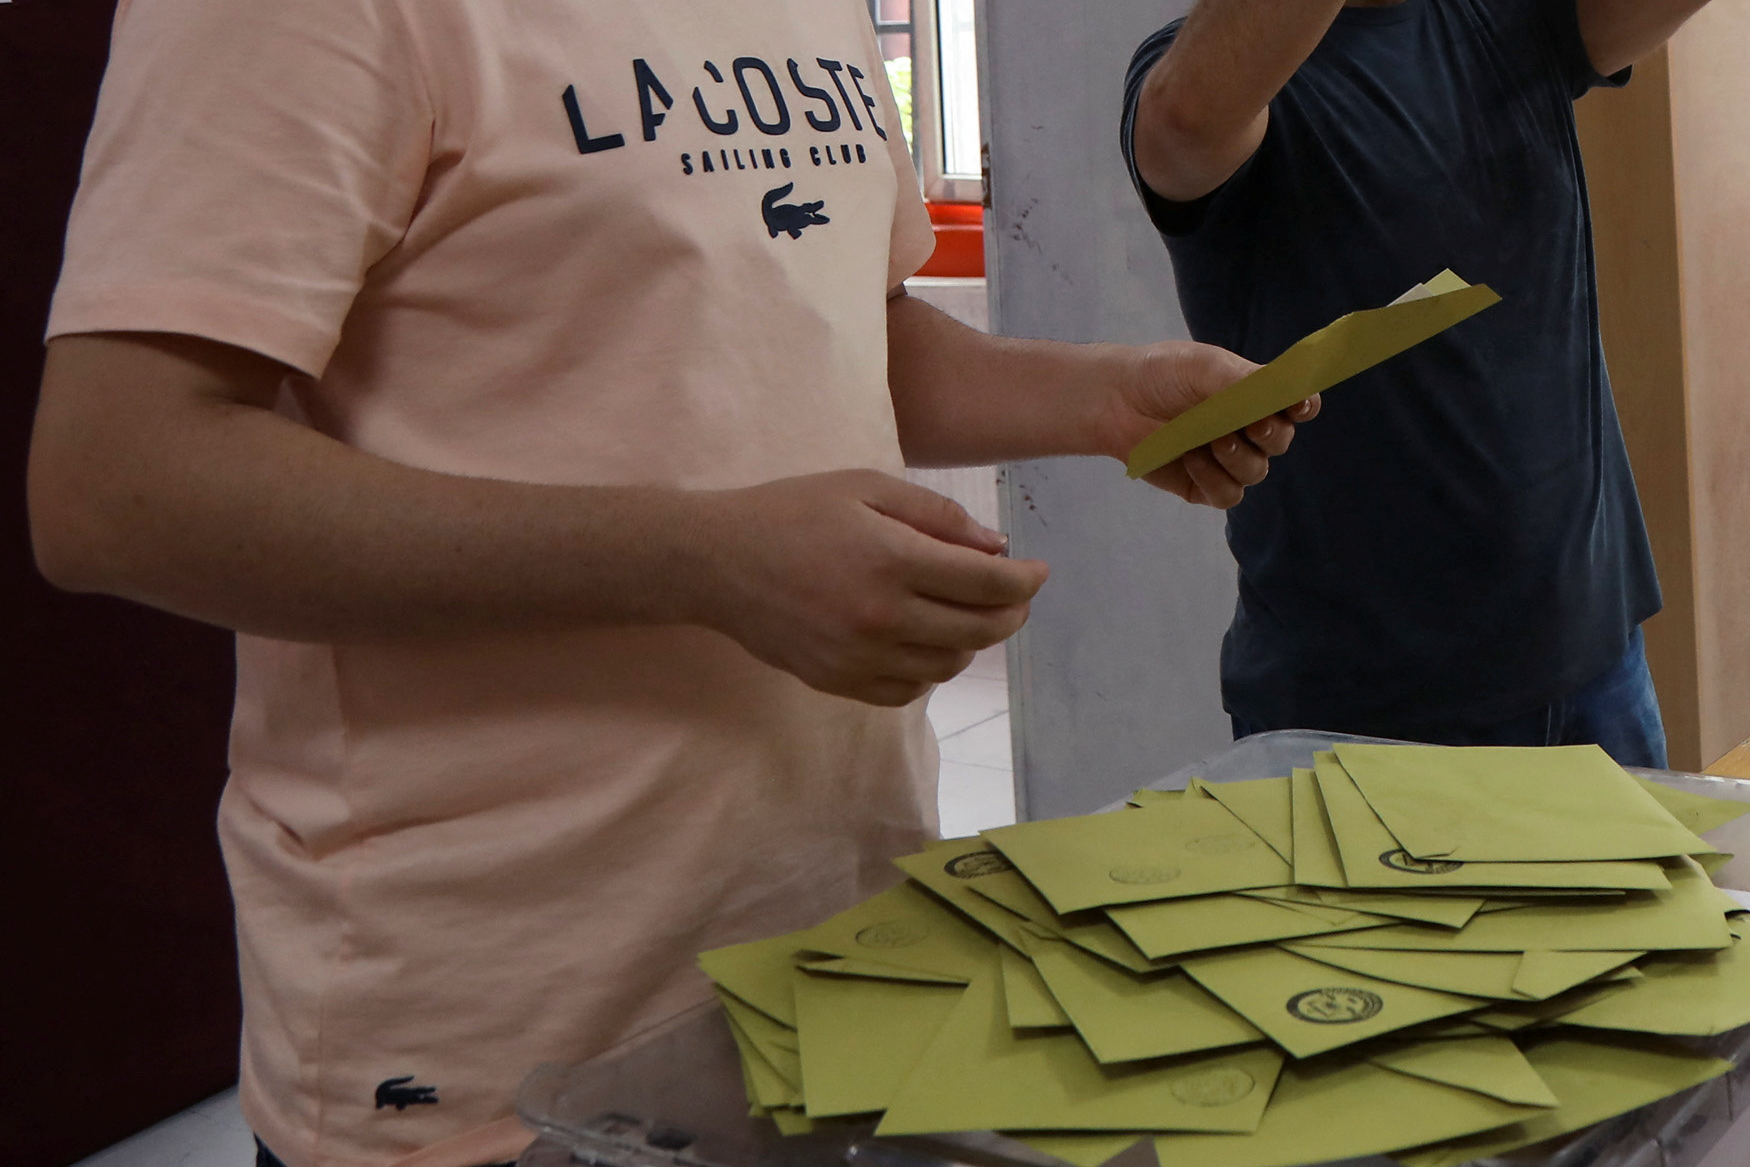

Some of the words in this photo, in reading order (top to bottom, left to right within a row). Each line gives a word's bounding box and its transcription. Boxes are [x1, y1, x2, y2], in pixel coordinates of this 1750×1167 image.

[562, 56, 887, 155] LACOSTE
[681, 147, 792, 175] SAILING
[810, 144, 867, 167] CLUB
